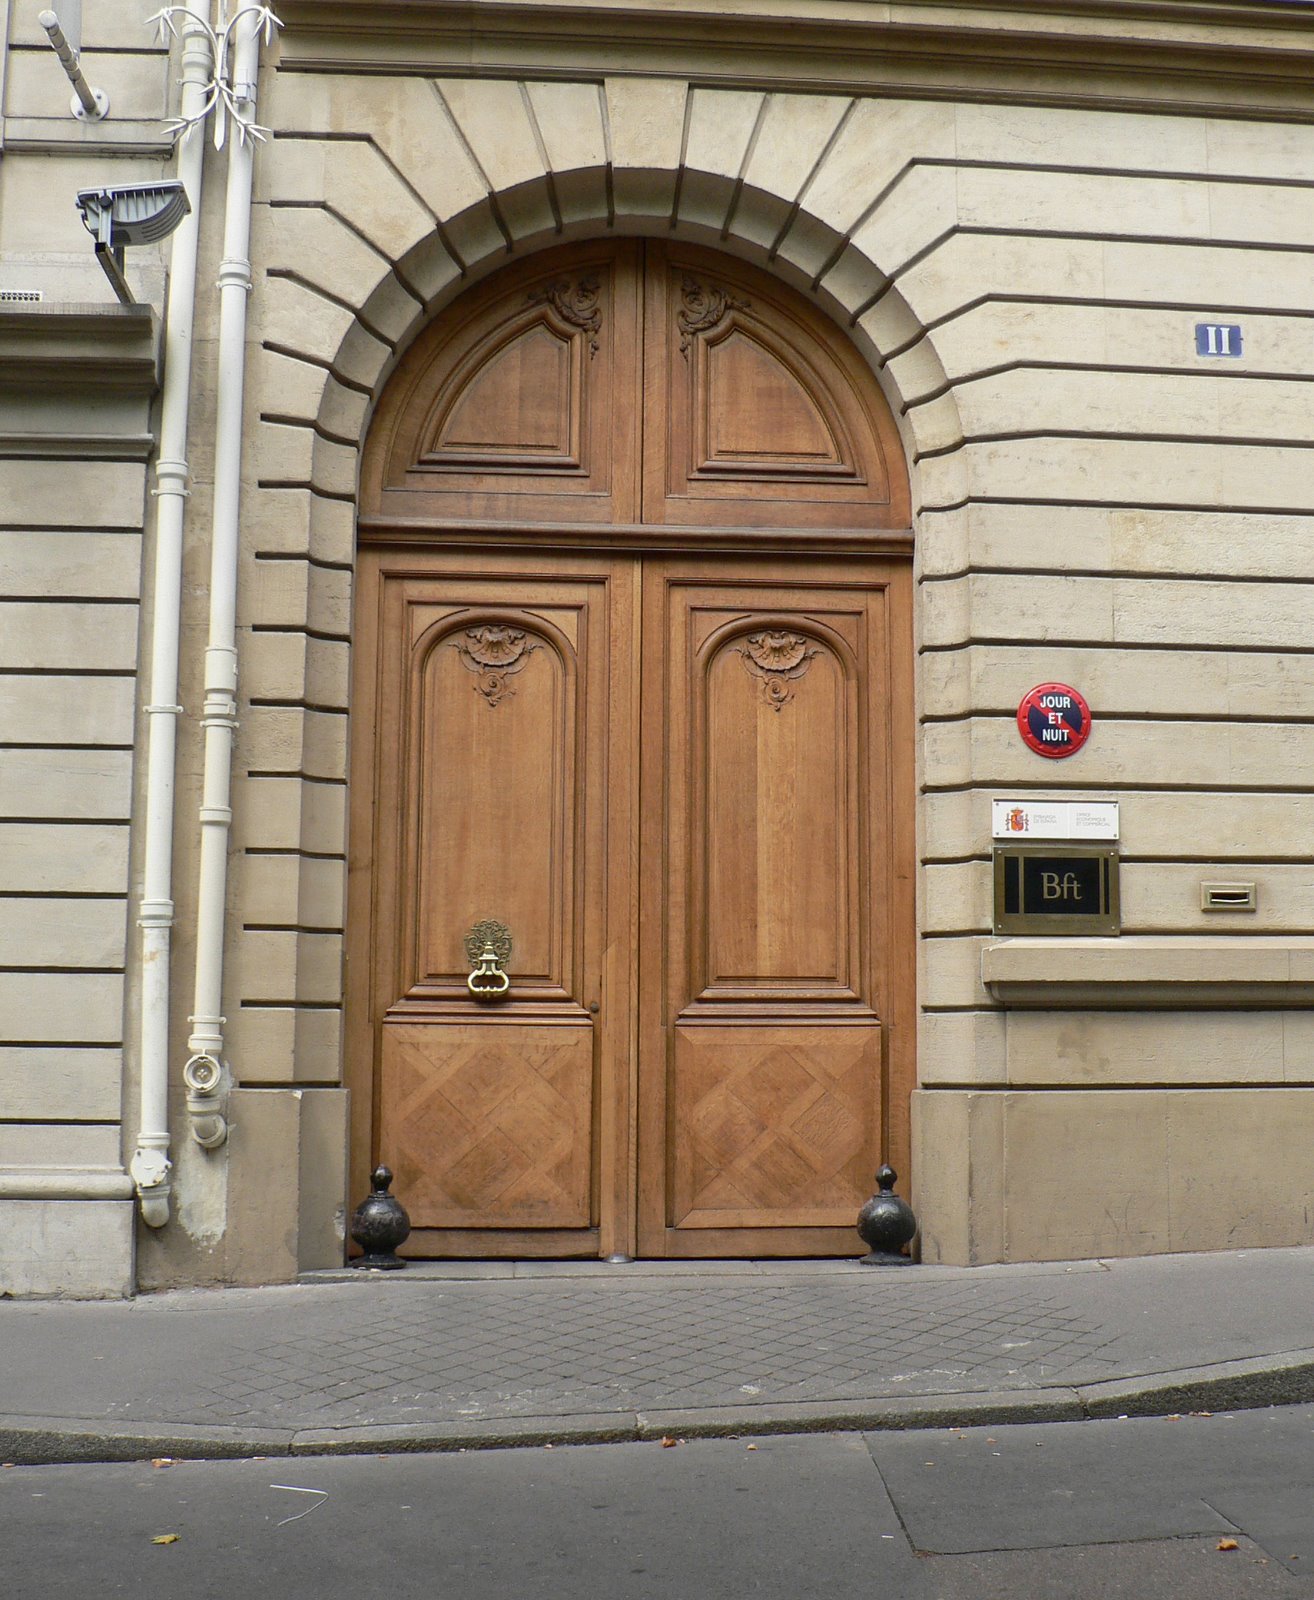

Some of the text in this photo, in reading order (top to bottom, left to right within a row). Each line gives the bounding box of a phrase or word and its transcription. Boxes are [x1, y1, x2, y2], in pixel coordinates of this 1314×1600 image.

[1206, 326, 1231, 354] 11
[1040, 696, 1071, 708] JOUR
[1048, 712, 1063, 724] ET
[1042, 729, 1069, 741] NUIT
[1041, 872, 1083, 900] Bft
